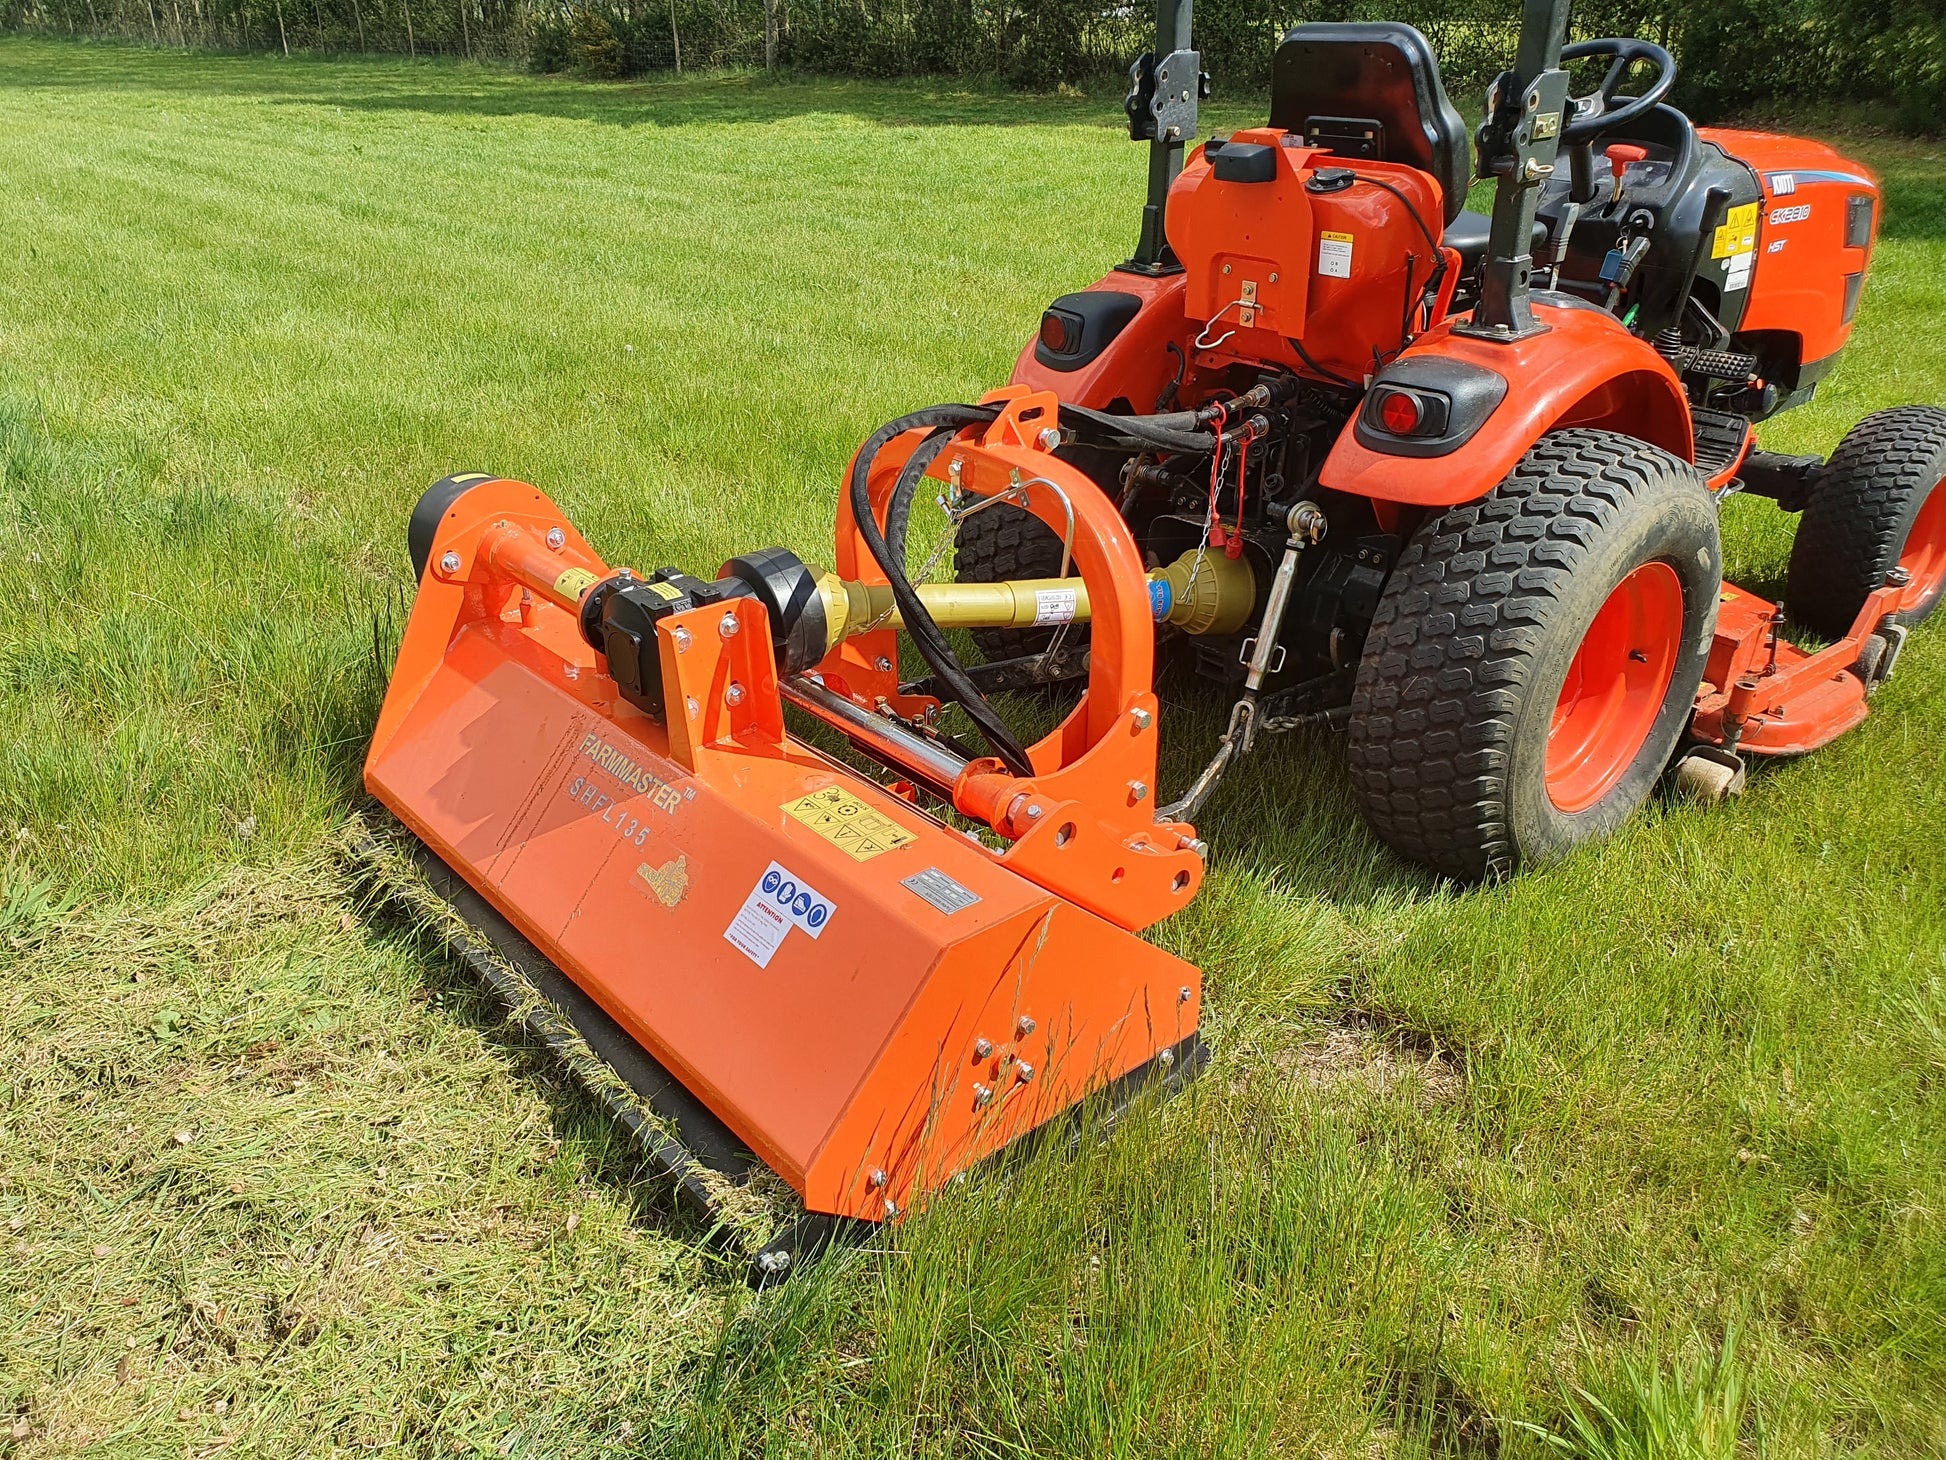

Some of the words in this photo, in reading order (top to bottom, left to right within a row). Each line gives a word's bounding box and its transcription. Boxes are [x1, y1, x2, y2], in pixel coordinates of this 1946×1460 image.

[1767, 239, 1788, 254] HST
[578, 733, 682, 816] FARMMASTER
[757, 902, 783, 924] ATTENTION
